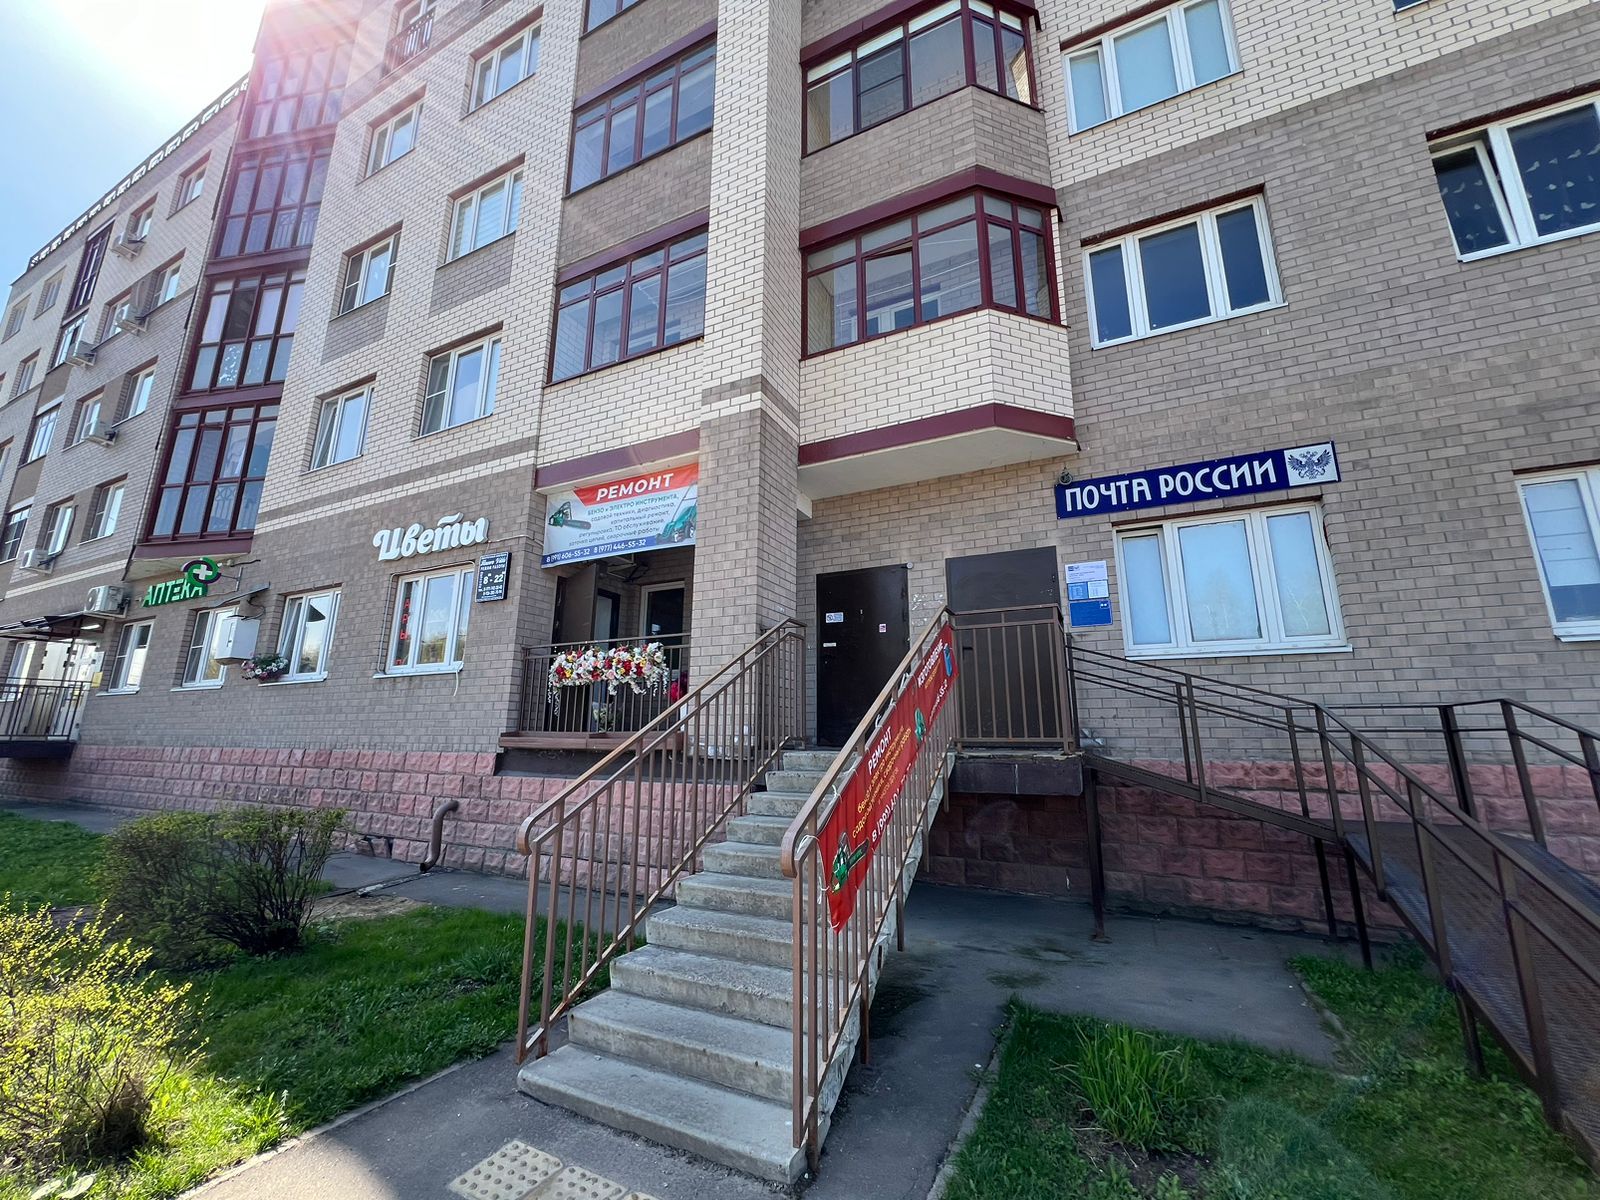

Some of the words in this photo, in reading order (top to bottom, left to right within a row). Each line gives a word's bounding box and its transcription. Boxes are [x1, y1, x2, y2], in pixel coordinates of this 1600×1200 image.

[596, 473, 674, 502] РЕМОНТ
[1065, 477, 1152, 511] ПОЧТА
[1159, 458, 1276, 499] РОССИИ
[609, 501, 634, 511] ЭЛЕКТРО
[372, 512, 489, 562] Цветы
[141, 578, 203, 608] АПТЕКА
[867, 726, 892, 775] РЕМОНТ
